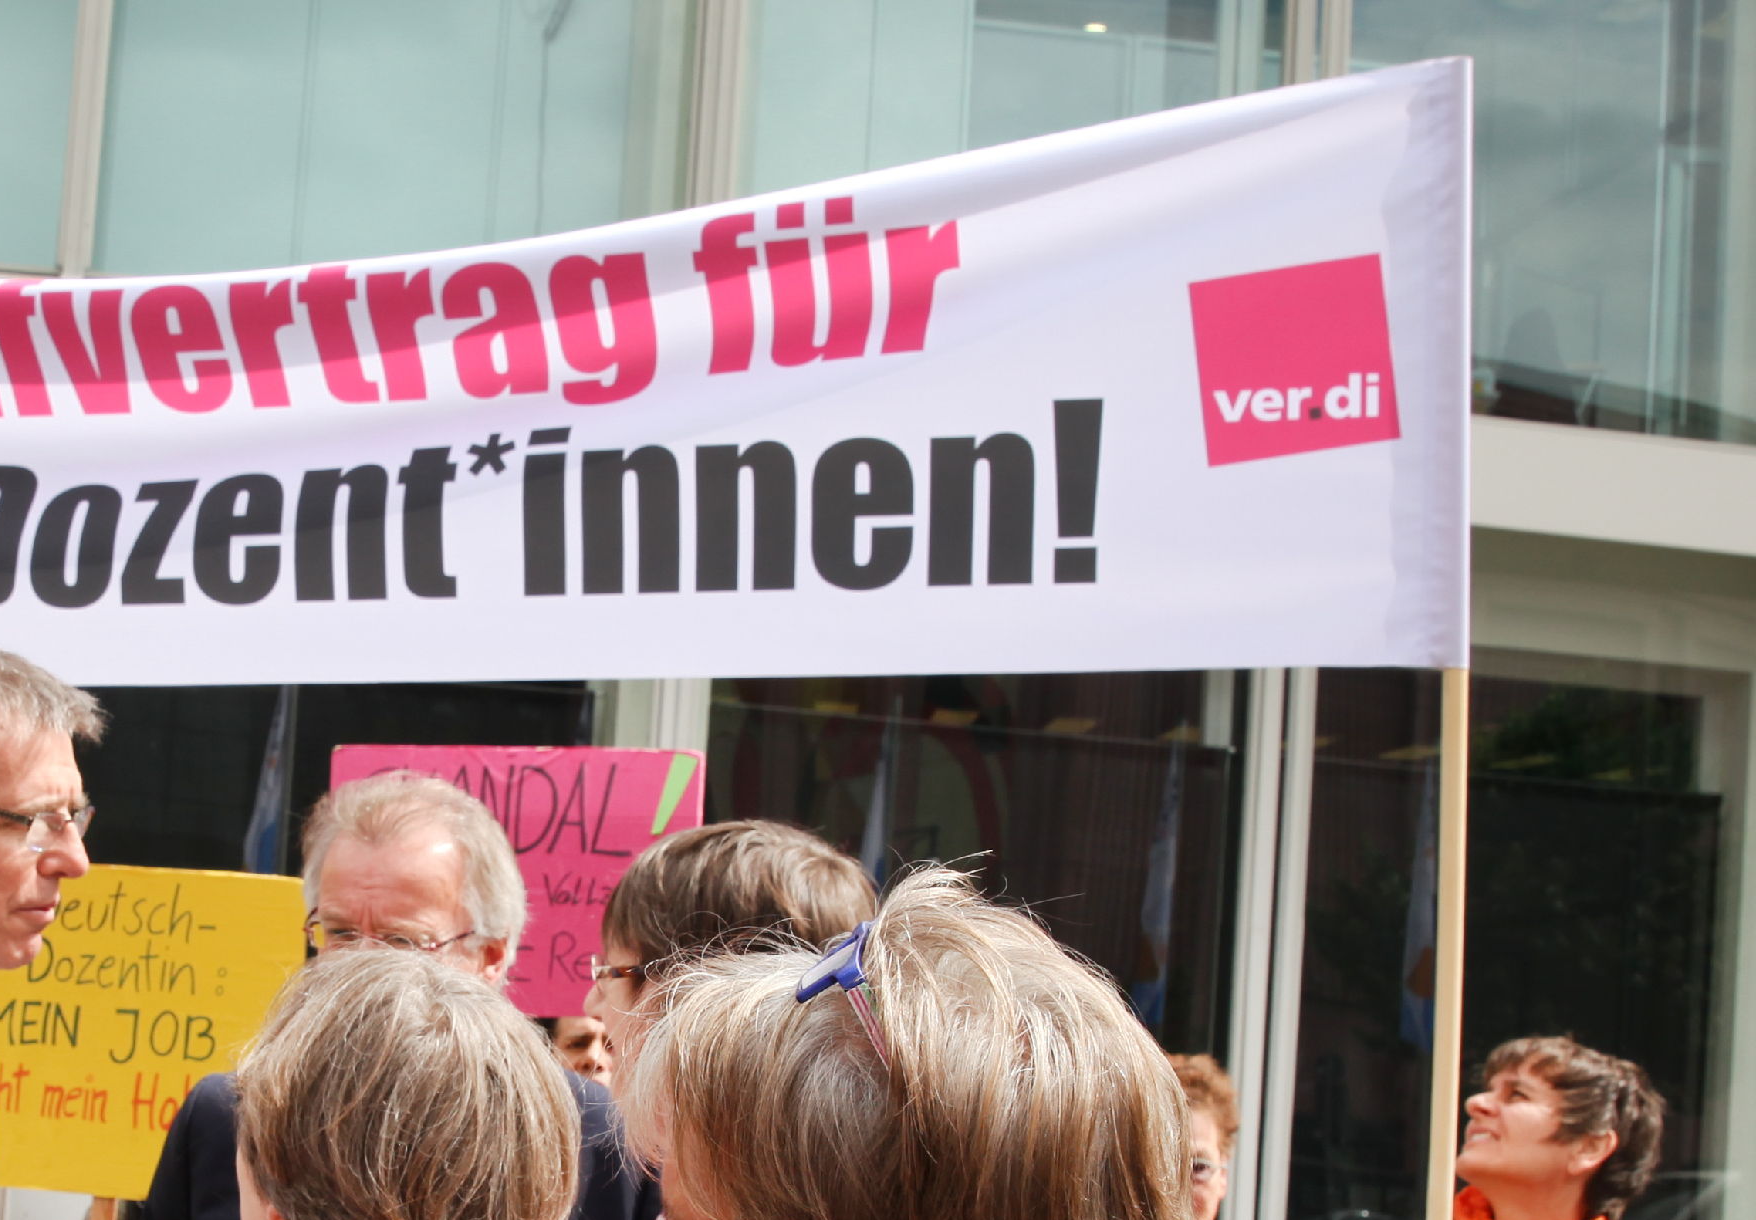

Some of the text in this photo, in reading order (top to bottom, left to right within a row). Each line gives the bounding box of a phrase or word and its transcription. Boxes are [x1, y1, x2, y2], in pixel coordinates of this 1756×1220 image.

[693, 195, 961, 376] für
[1214, 372, 1381, 423] ver.di
[54, 881, 217, 945] eutsch-
[108, 1008, 218, 1064] JOB
[40, 1074, 108, 1125] mein
